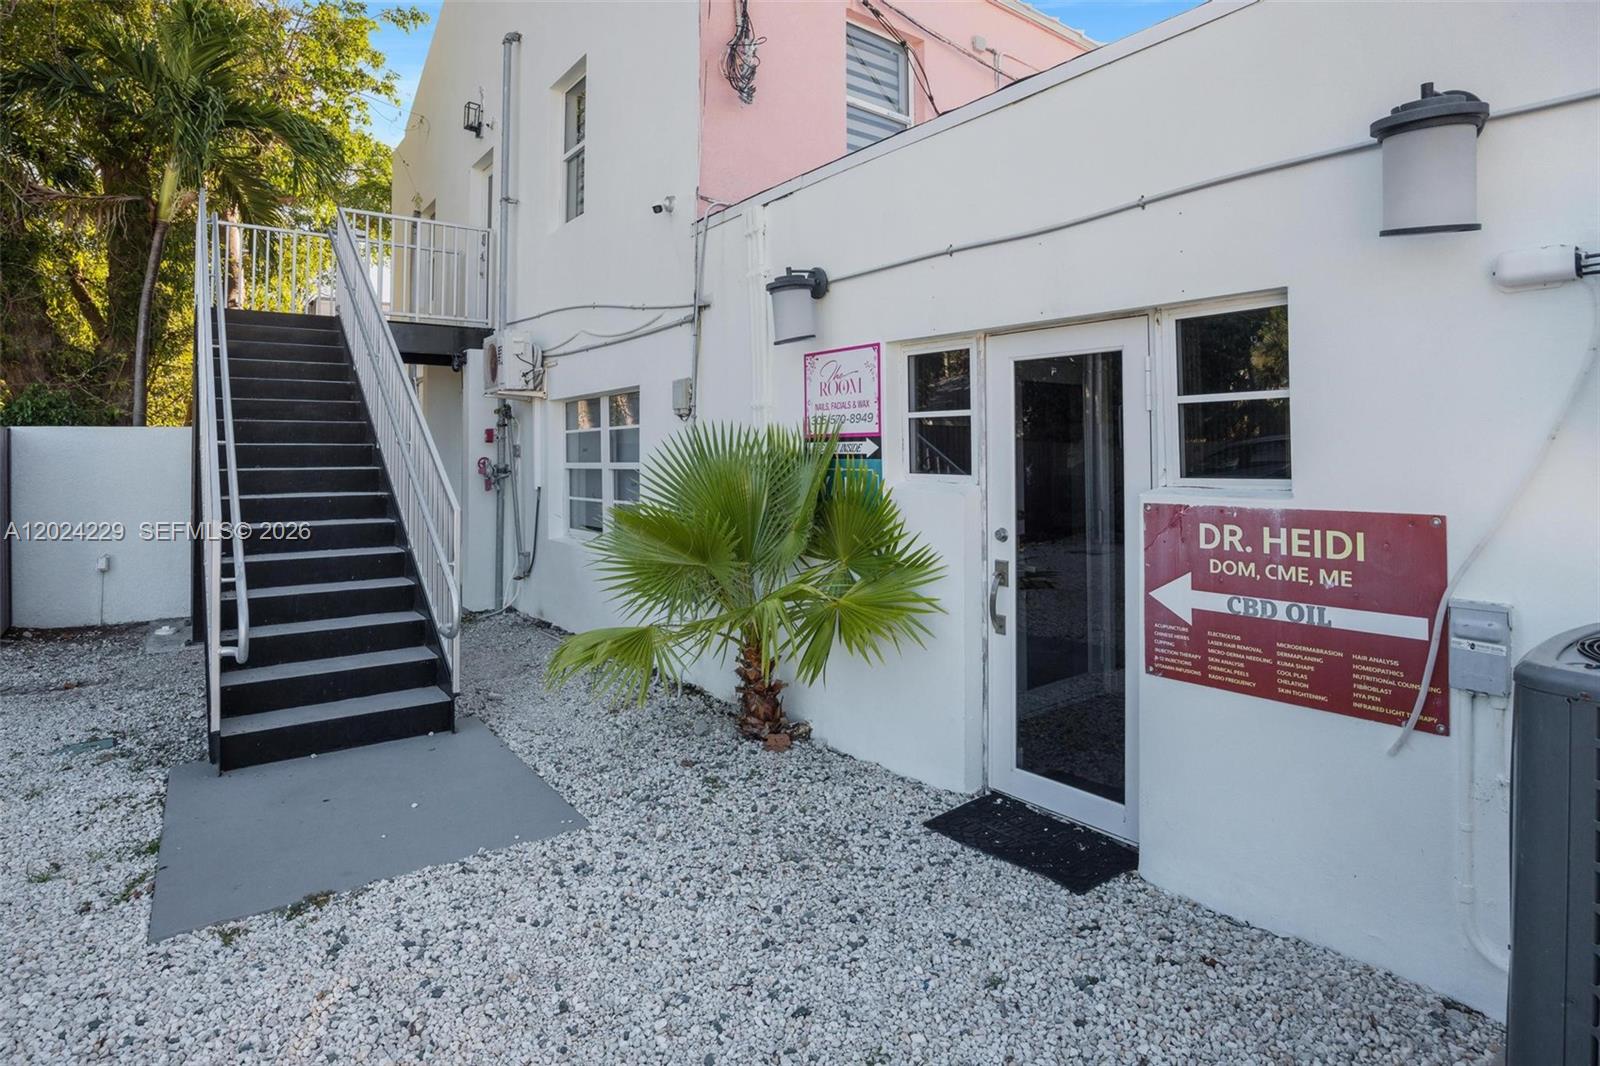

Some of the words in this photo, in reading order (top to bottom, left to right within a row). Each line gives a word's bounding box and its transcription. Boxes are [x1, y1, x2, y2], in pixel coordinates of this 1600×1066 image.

[820, 360, 858, 382] The
[819, 377, 862, 397] ROOM
[830, 401, 852, 410] FACIALS
[852, 400, 857, 408] &
[857, 400, 870, 408] WAX
[811, 413, 874, 425] 305570-8949
[839, 443, 863, 453] INSIDE
[1199, 523, 1252, 553] DR.
[1263, 526, 1365, 562] HEIDI
[1209, 558, 1261, 581] DOM,
[1265, 564, 1313, 586] CME,
[1319, 569, 1353, 588] ME
[1226, 596, 1278, 620] CBD
[1285, 603, 1332, 628] OIL
[1154, 631, 1174, 639] CHINESE
[1208, 631, 1241, 641] ELECTROLYSIS
[1154, 639, 1175, 647] CUPPING
[1236, 644, 1263, 654] REMOVAL
[1154, 648, 1179, 656] INJECTION
[1179, 651, 1201, 660] THERAPY
[1276, 642, 1344, 657] MICRODERMABRASION
[1208, 648, 1245, 660] MICRO-DERMA
[1246, 655, 1273, 665] NEEDLING
[1276, 651, 1324, 664] DERMAPLANING
[1368, 656, 1399, 666] ANALYSIS
[1154, 663, 1175, 671] VITAMIN
[1175, 667, 1202, 676] INFUSIONS
[1221, 659, 1245, 668] ANALYSIS
[1277, 660, 1295, 668] KUMA
[1295, 663, 1315, 672] SHAPE
[1208, 665, 1233, 674] CHEMICAL
[1233, 669, 1249, 677] PEELS
[1276, 669, 1292, 677] COOL
[1293, 672, 1308, 680] PLAS
[1352, 664, 1404, 677] HOMEOPATHICS
[1208, 673, 1225, 681] RADIO
[1225, 677, 1256, 688] FREQUENCY
[1276, 678, 1309, 689] CHELATION
[1352, 673, 1396, 686] NUTRITIONAL
[1397, 681, 1442, 694] COUNSING
[1278, 687, 1292, 695] SKIN
[1292, 690, 1328, 702] TIGHTENING
[1353, 683, 1393, 695] FIBROBLAST
[1353, 692, 1367, 700] HYA
[1367, 694, 1381, 702] PEN
[1352, 702, 1385, 713] INFRARED
[1385, 708, 1406, 718] LIGHT
[1406, 712, 1438, 724] TRAPY
